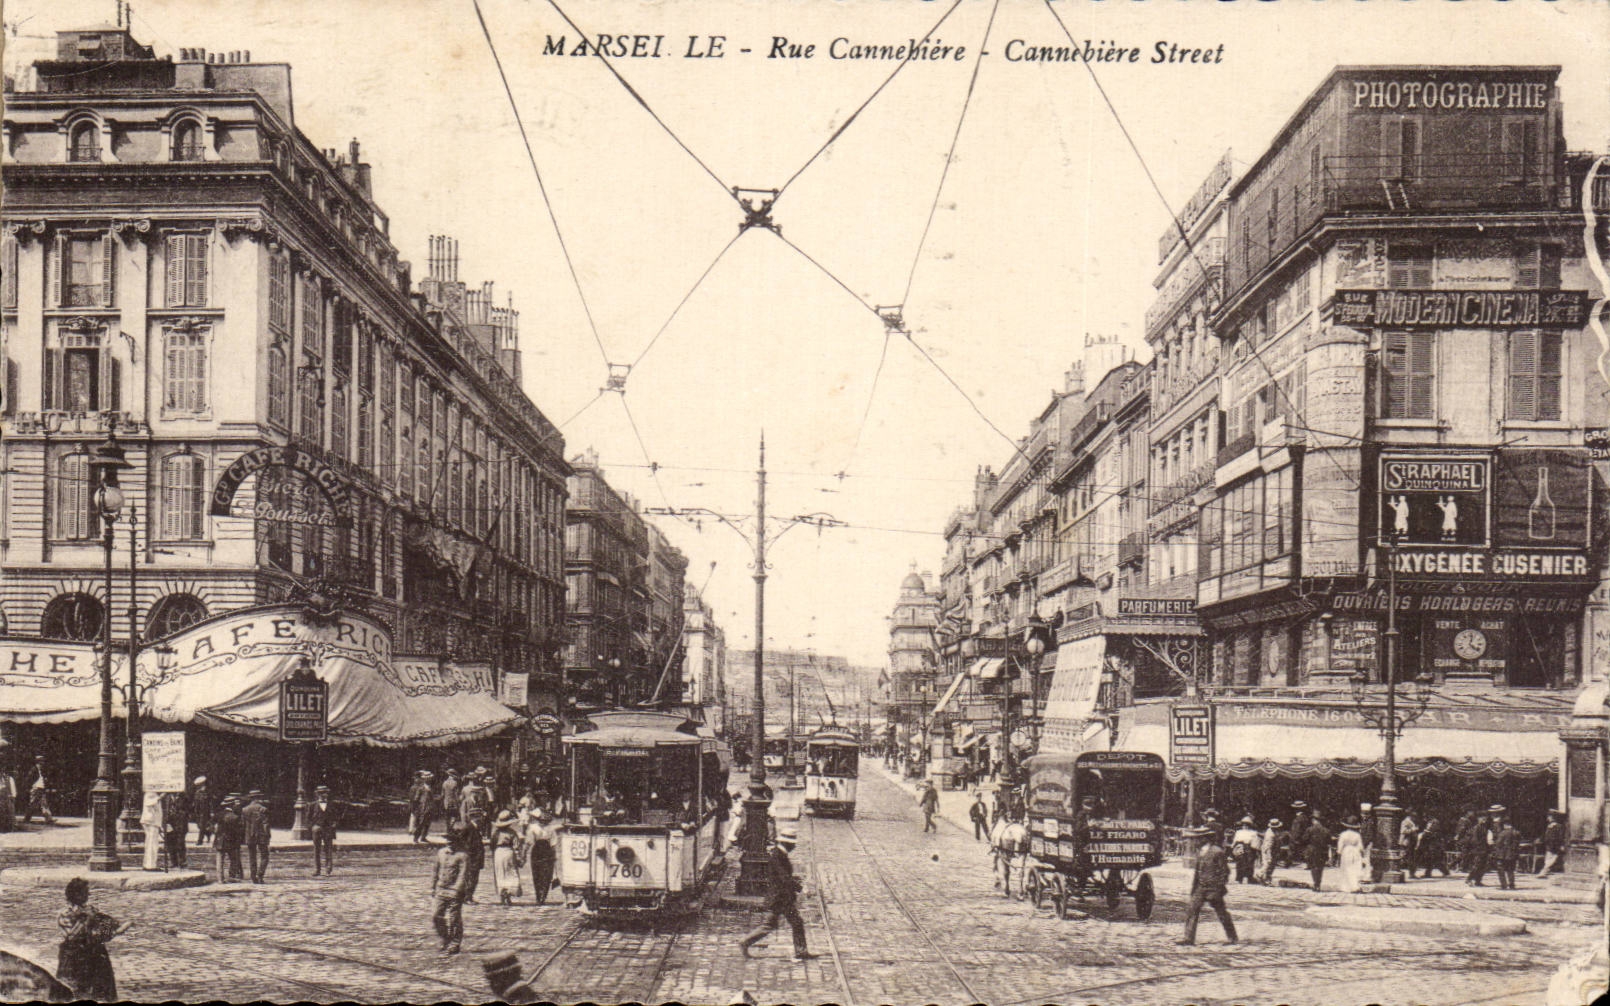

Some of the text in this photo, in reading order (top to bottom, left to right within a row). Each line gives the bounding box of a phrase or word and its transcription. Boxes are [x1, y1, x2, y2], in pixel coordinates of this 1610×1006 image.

[1353, 81, 1548, 109] PHOTOGRAPHIE
[1404, 480, 1469, 490] QUINQUINA
[1492, 554, 1588, 576] CUSENIER
[1121, 600, 1194, 614] PARFUMERIE
[1419, 595, 1514, 612] HORLOGERS
[286, 693, 324, 712] LILET
[1173, 716, 1209, 737] LILET
[1107, 831, 1147, 840] FIGARO
[609, 863, 643, 879] 760
